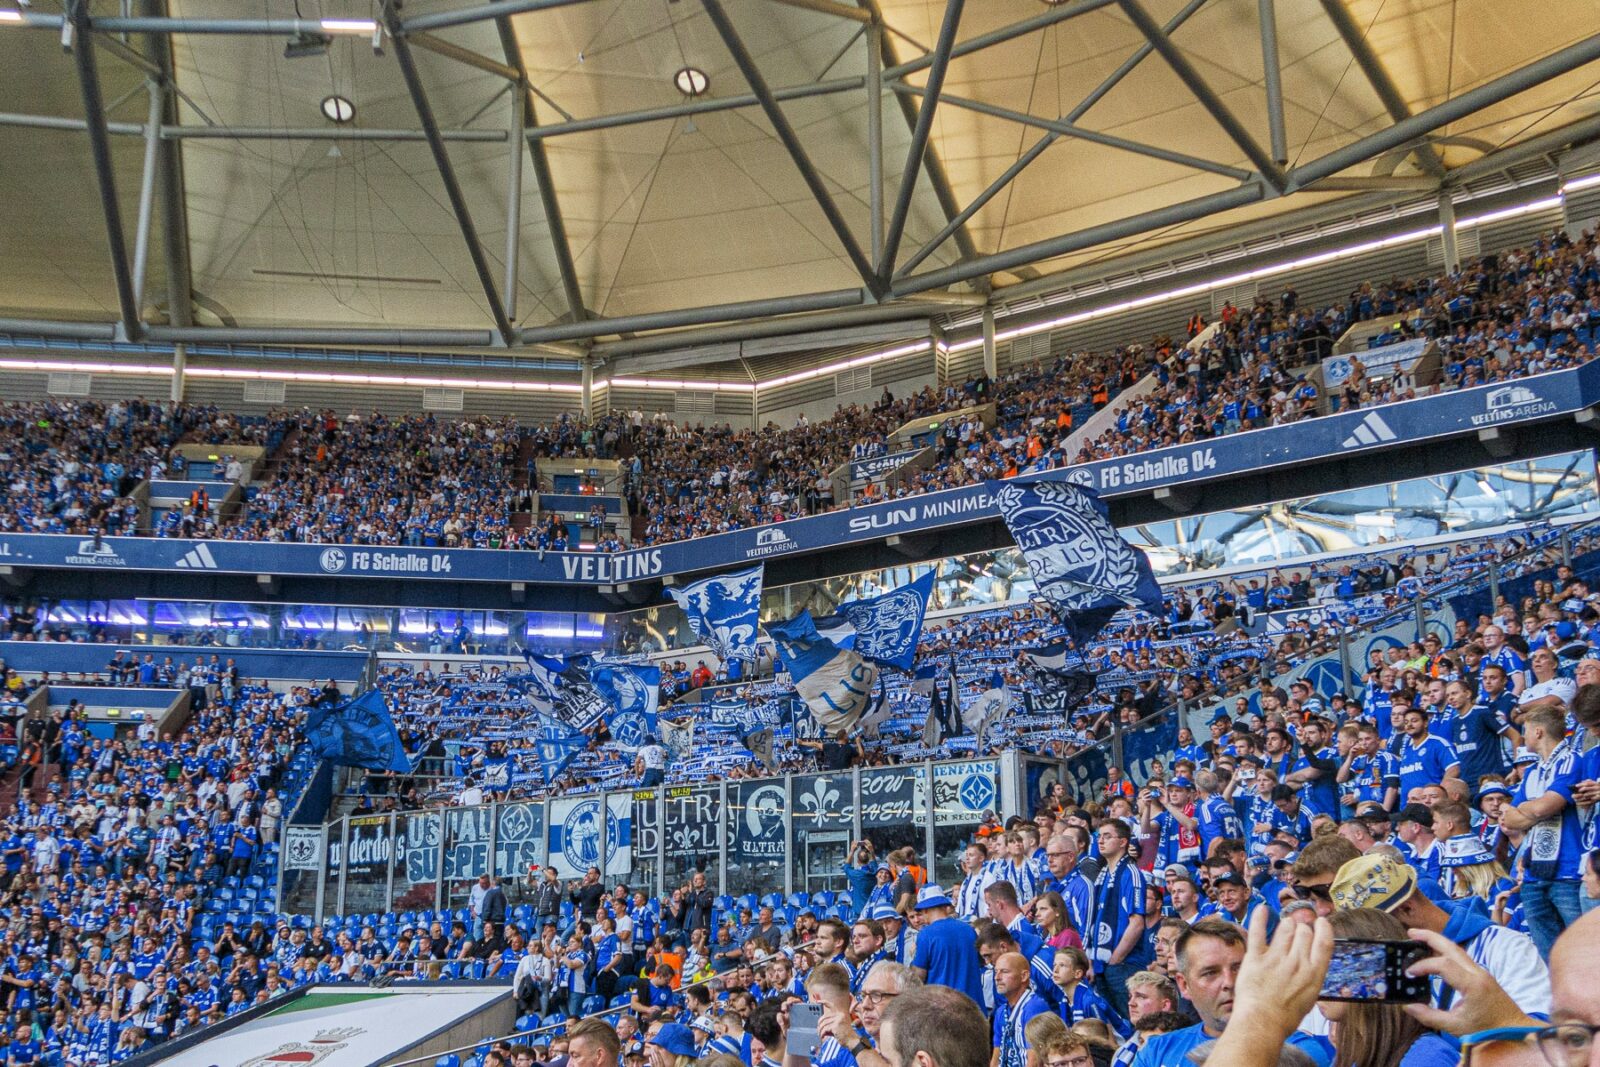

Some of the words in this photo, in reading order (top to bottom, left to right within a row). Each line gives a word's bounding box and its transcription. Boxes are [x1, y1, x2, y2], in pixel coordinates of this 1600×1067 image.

[1515, 401, 1557, 417] ARENA
[1101, 466, 1120, 489] FC
[1124, 456, 1189, 485] Schalke
[1192, 448, 1217, 472] 04
[849, 507, 917, 533] SUN
[923, 494, 999, 519] MINIMEA
[96, 557, 127, 565] ARENA
[352, 552, 369, 570] FC
[372, 552, 428, 572] Schalke
[431, 554, 451, 572] 04
[746, 546, 773, 557] VELTINS
[773, 541, 798, 552] ARENA
[1060, 539, 1096, 565] LIS
[562, 549, 662, 580] VELTINS
[911, 763, 993, 779] LIIENFANS
[408, 809, 491, 848] USUAL
[915, 813, 948, 824] GEEN
[330, 825, 405, 867] uderdos
[640, 827, 673, 852] DE
[701, 822, 736, 848] LIS
[408, 840, 536, 881] SUSPECTS
